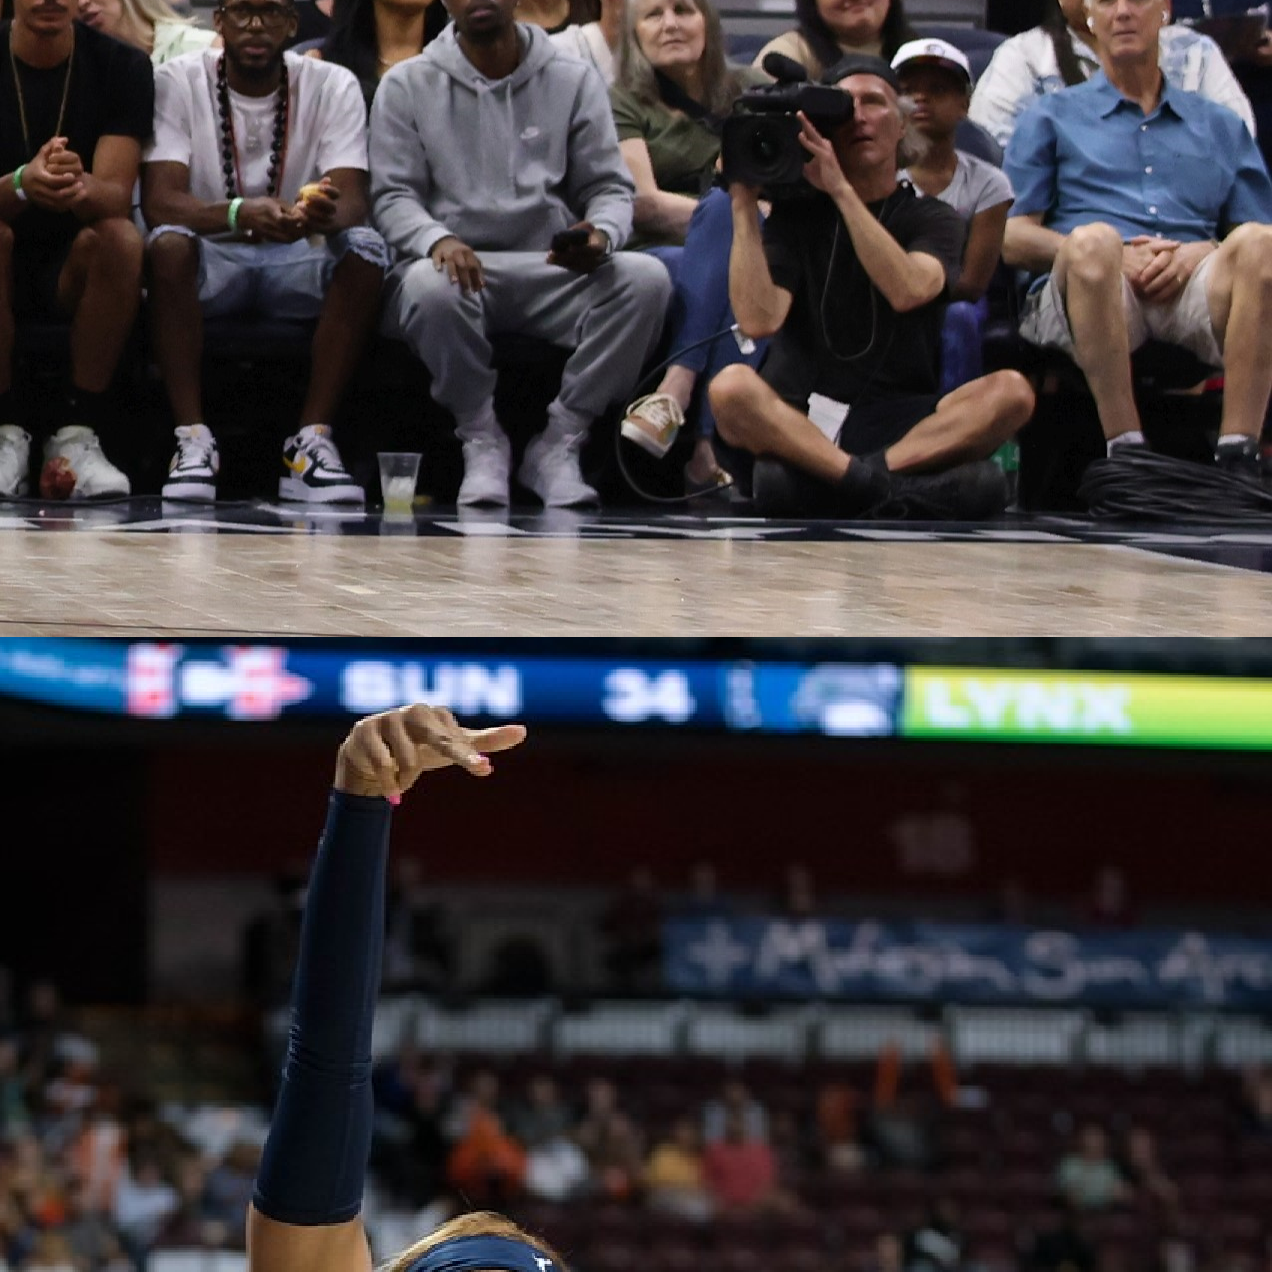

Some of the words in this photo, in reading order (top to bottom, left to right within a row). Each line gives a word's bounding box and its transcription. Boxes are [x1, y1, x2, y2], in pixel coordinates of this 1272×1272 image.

[338, 659, 523, 718] SUN
[601, 667, 696, 724] 34
[923, 678, 1136, 735] LYNX
